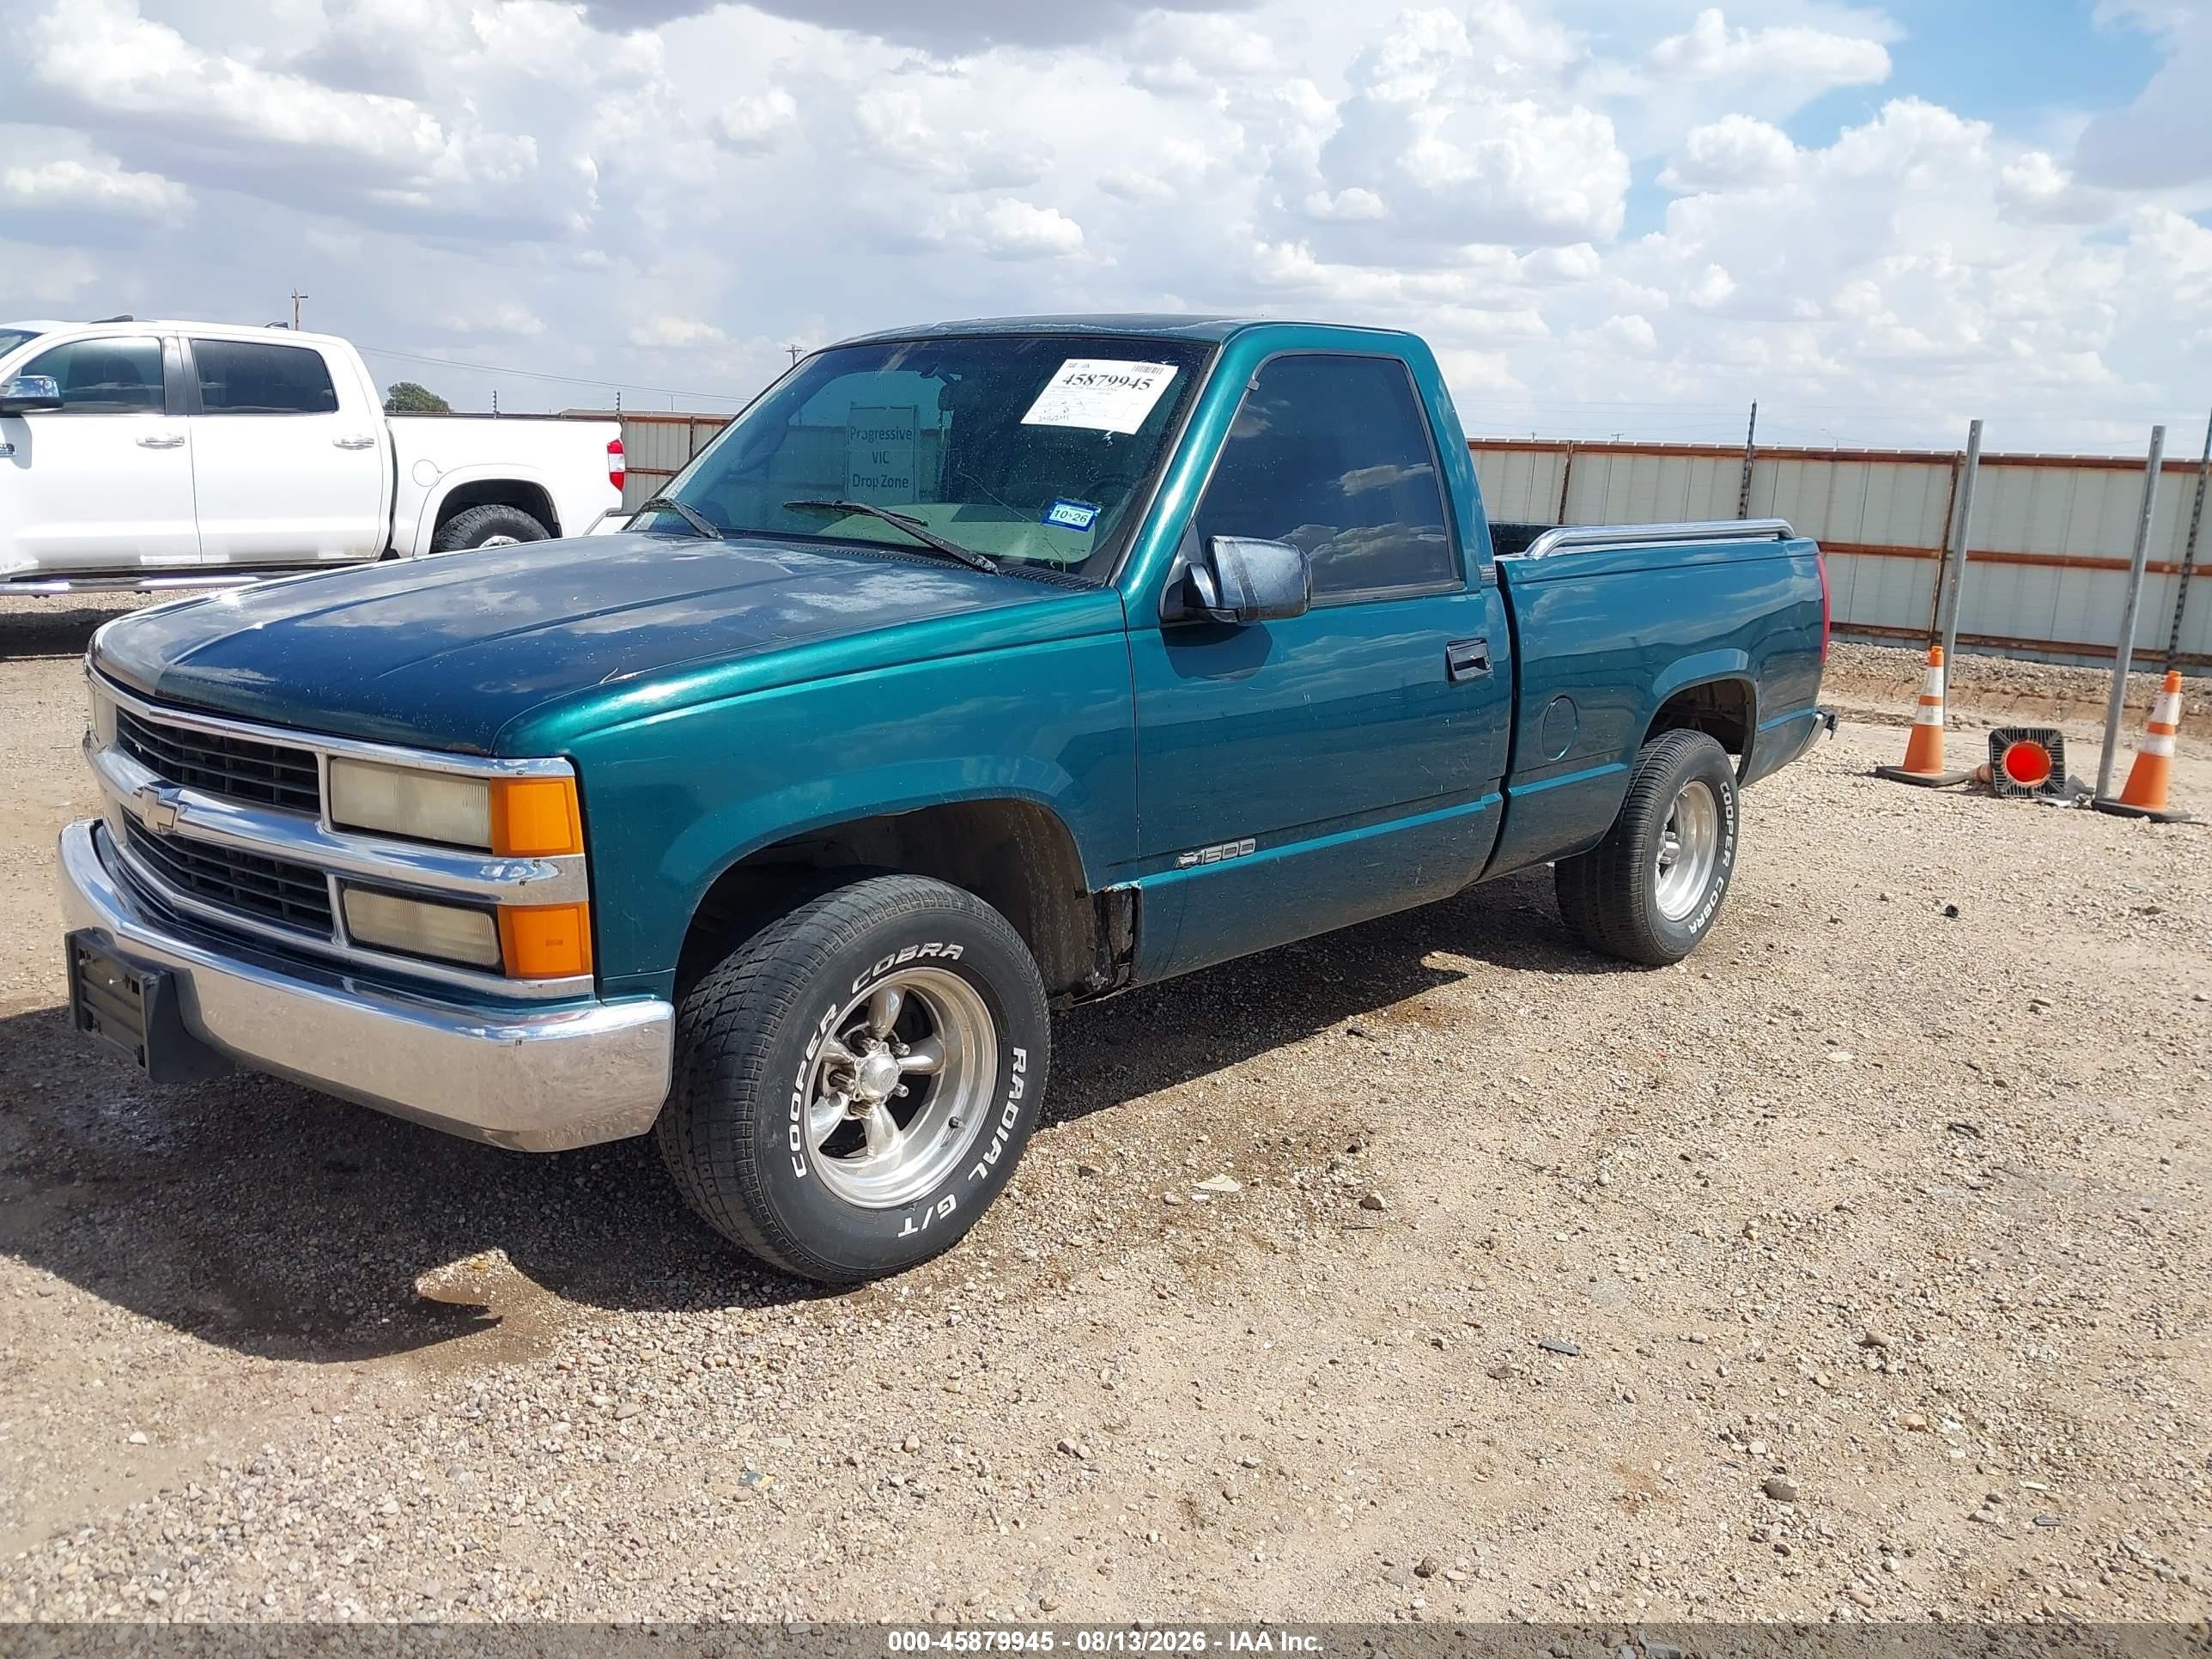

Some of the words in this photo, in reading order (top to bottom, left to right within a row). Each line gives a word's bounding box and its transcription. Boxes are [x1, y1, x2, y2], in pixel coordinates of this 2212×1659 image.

[1062, 373, 1154, 391] 45879945
[850, 426, 913, 443] Progressive
[872, 450, 890, 464] VIC
[853, 473, 878, 491] Drop
[881, 474, 908, 489] Zone
[1719, 781, 1735, 868] COOPER
[1198, 837, 1256, 864] 1500
[1688, 876, 1724, 934] COBRA
[851, 941, 964, 994] COBRA
[788, 1002, 838, 1178] COOPER
[968, 1046, 1029, 1182] RADIAL
[897, 1193, 957, 1238] G/T
